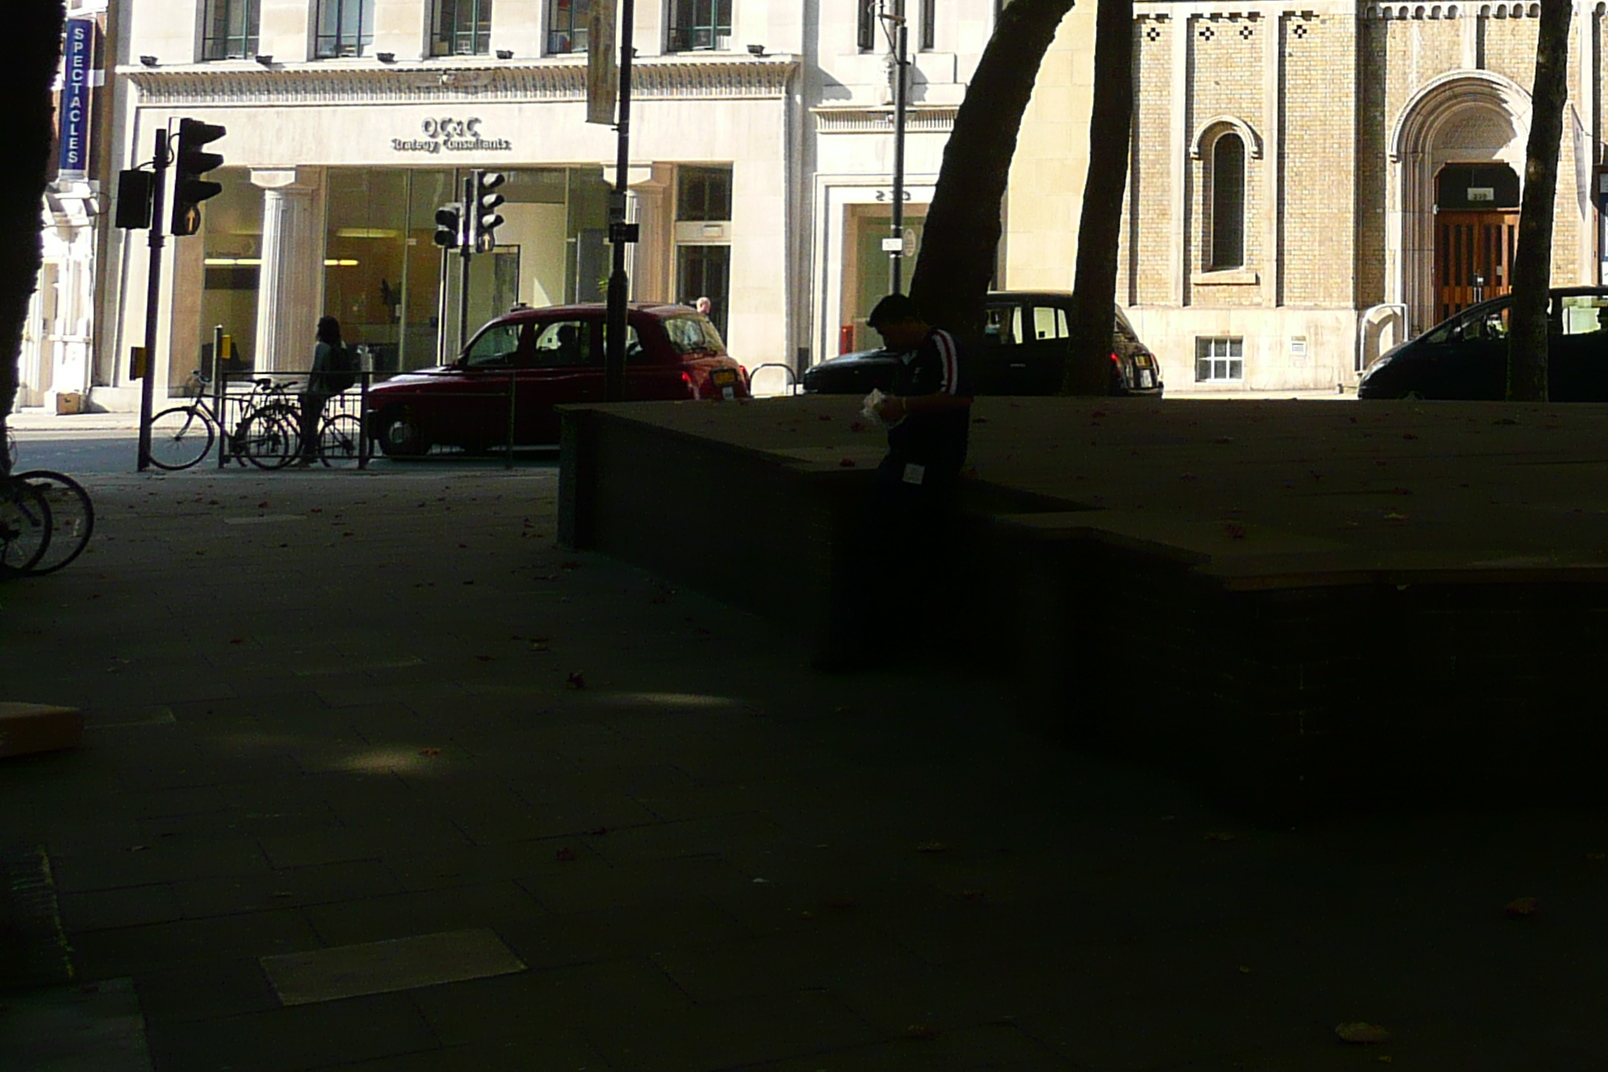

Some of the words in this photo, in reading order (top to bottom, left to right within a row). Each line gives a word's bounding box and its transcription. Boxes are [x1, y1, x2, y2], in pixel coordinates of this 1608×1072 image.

[67, 28, 85, 164] SPECTACLES
[391, 138, 440, 154] Strategy
[443, 137, 513, 152] Consultants
